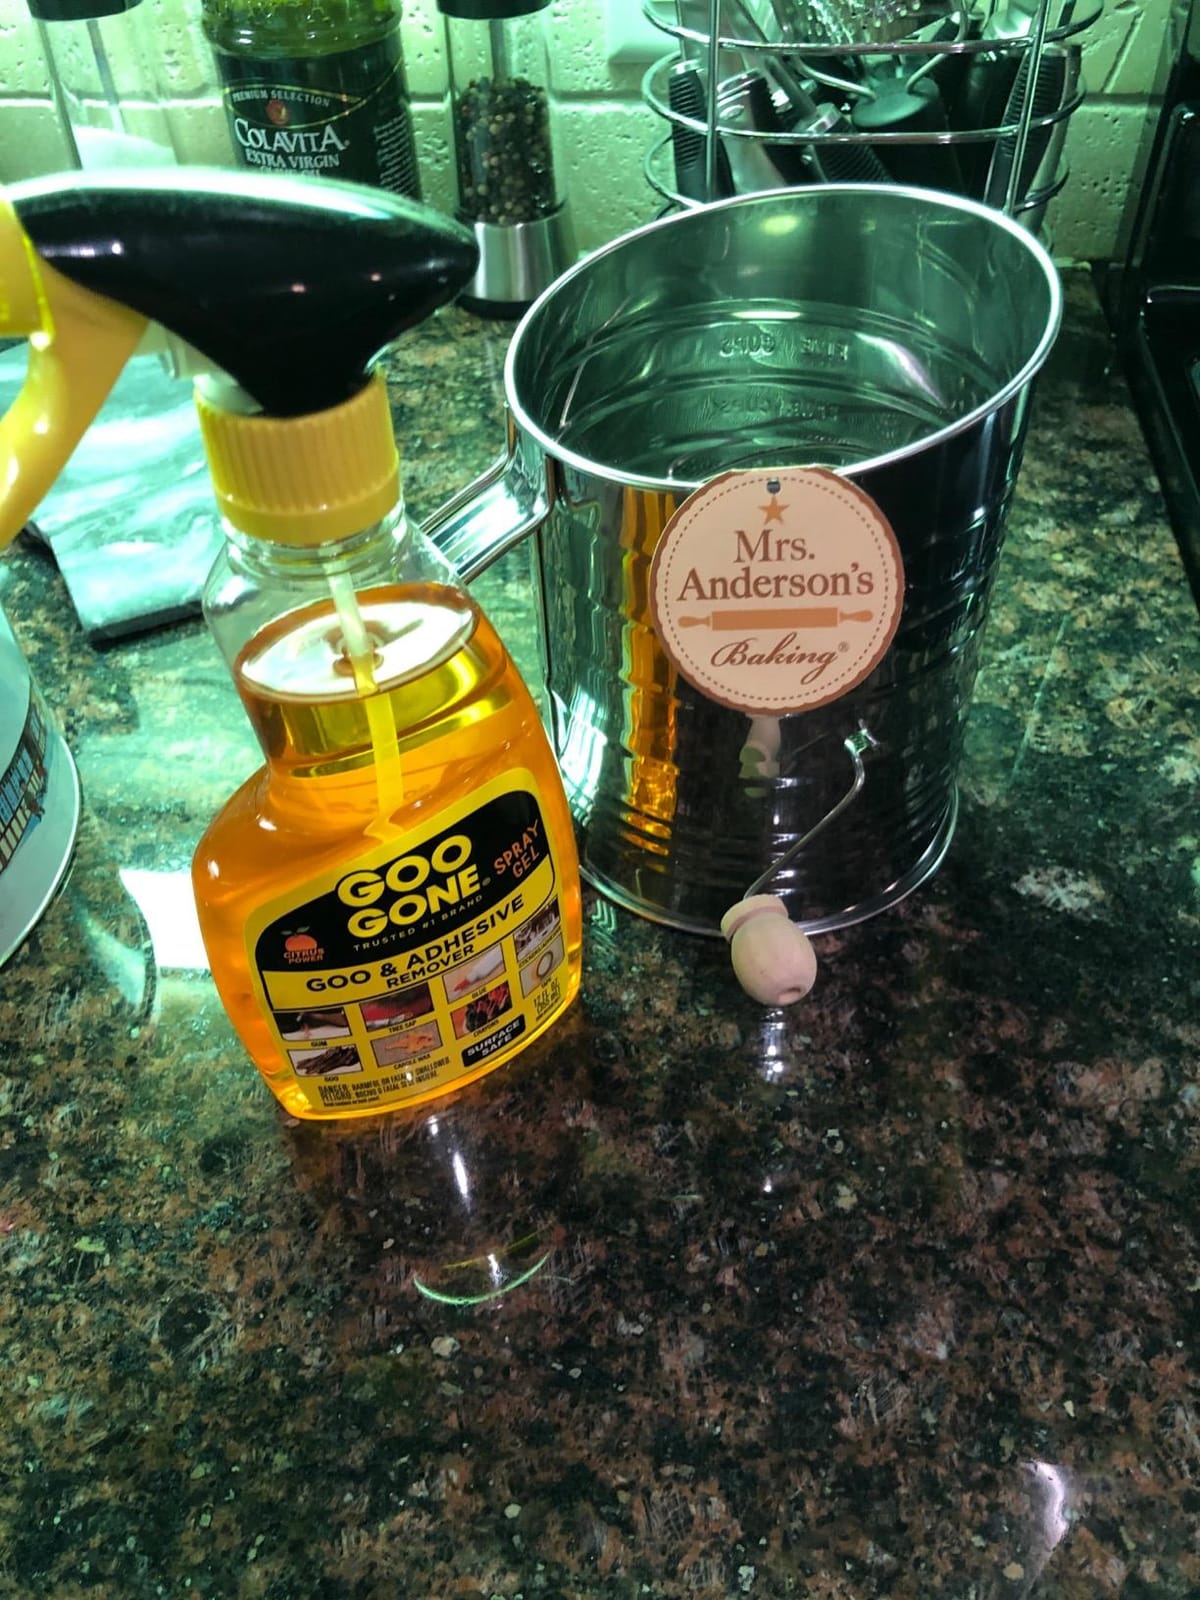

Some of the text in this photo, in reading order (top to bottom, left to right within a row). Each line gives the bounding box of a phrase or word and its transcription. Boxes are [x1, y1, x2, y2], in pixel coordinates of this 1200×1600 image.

[232, 89, 330, 107] PREMIUM SELECTION
[234, 118, 347, 153] COLAVITA
[245, 148, 340, 169] EXTRA VIRGIN
[733, 528, 816, 564] Mrs.
[676, 561, 875, 602] Anderson's
[494, 819, 539, 876] SPRAY
[512, 846, 541, 878] GEL
[337, 834, 473, 907] GOO
[347, 863, 482, 939] GONE
[353, 895, 483, 952] TRUSTED #1 BRAND
[283, 948, 325, 959] CITRUS
[288, 955, 324, 965] POWER
[306, 893, 525, 993] GOO & ADHESIVE
[386, 943, 475, 989] REMOVER
[466, 1019, 521, 1057] SURFACE
[481, 1033, 513, 1057] SAFE
